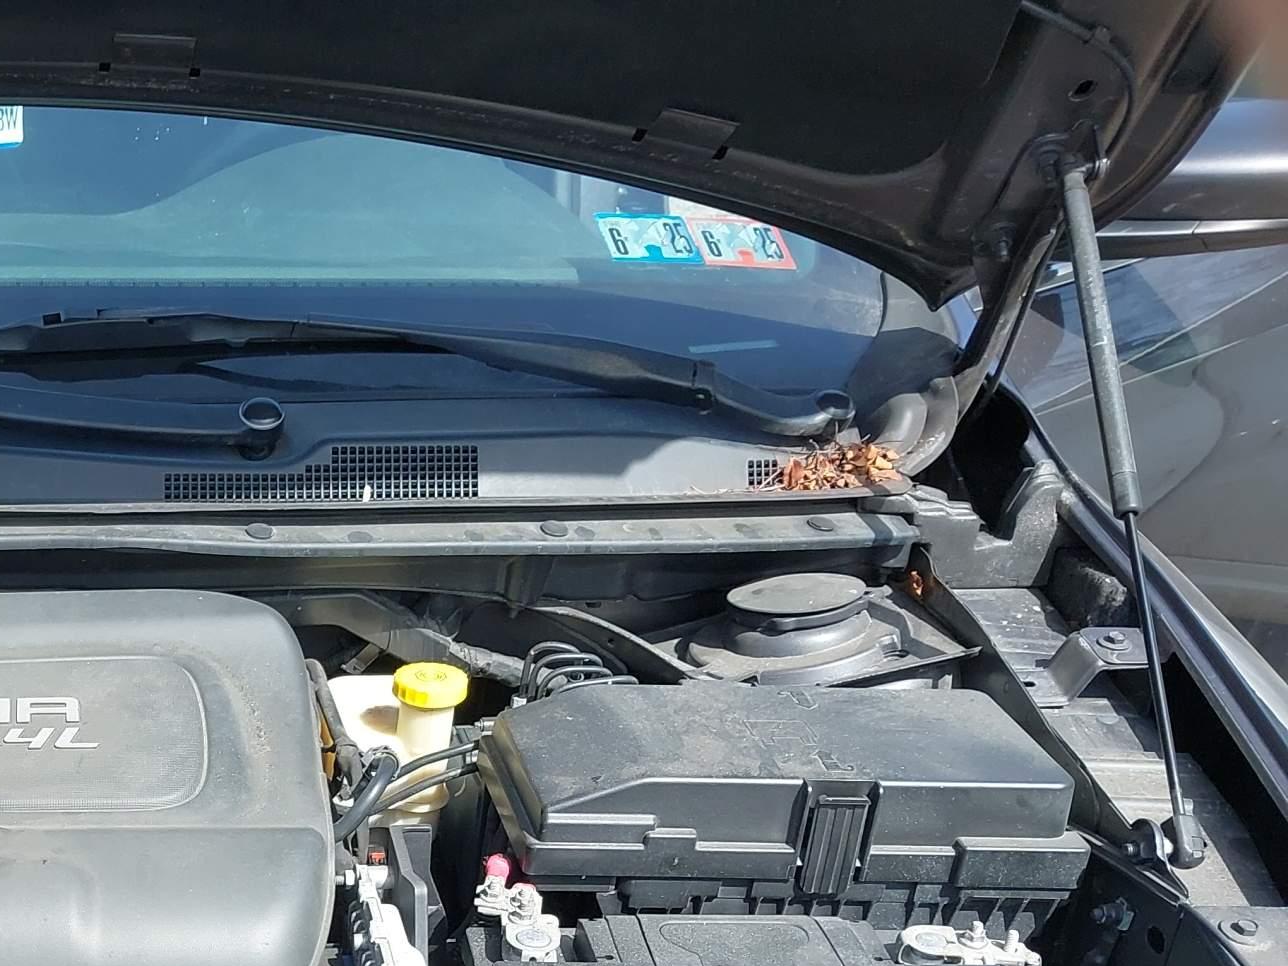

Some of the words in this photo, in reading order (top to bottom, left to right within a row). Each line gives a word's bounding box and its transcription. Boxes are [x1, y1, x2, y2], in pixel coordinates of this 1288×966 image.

[608, 227, 629, 256] 6
[663, 222, 694, 255] 25
[701, 230, 722, 258] 6
[753, 227, 785, 260] 25
